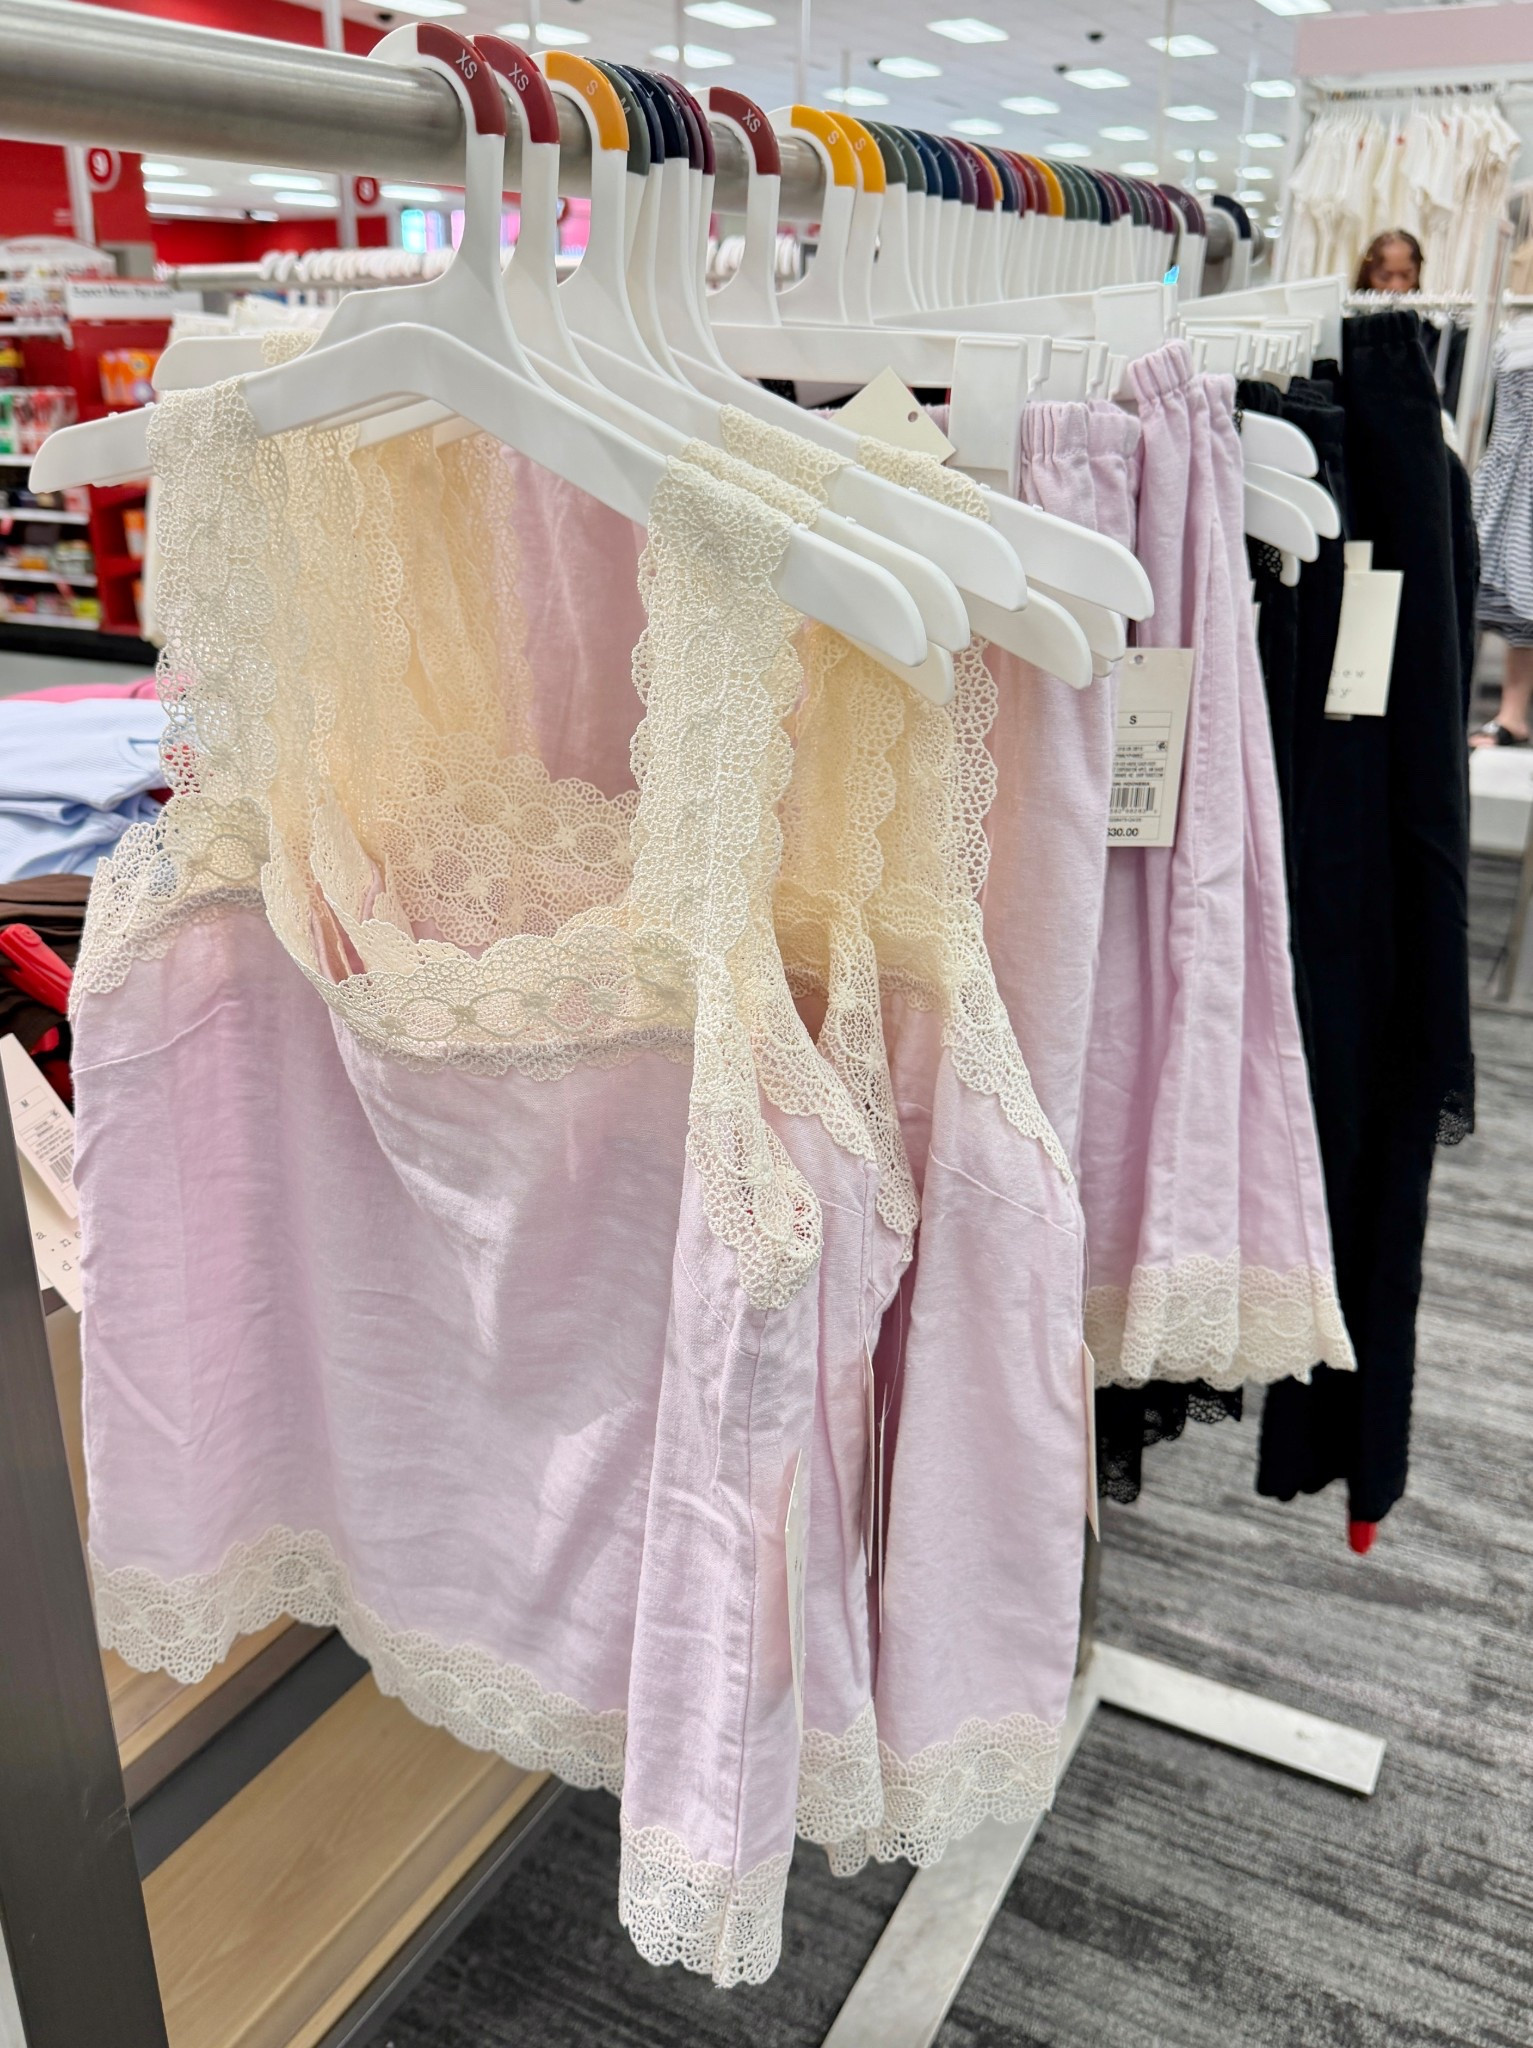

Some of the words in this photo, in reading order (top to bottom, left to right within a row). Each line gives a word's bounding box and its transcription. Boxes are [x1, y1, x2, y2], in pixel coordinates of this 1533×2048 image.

[455, 48, 478, 79] XS
[508, 62, 529, 92] XS
[586, 80, 599, 96] S
[742, 108, 761, 132] XS
[827, 130, 840, 145] S
[854, 137, 867, 151] S
[1129, 715, 1137, 725] S
[20, 1099, 30, 1109] M
